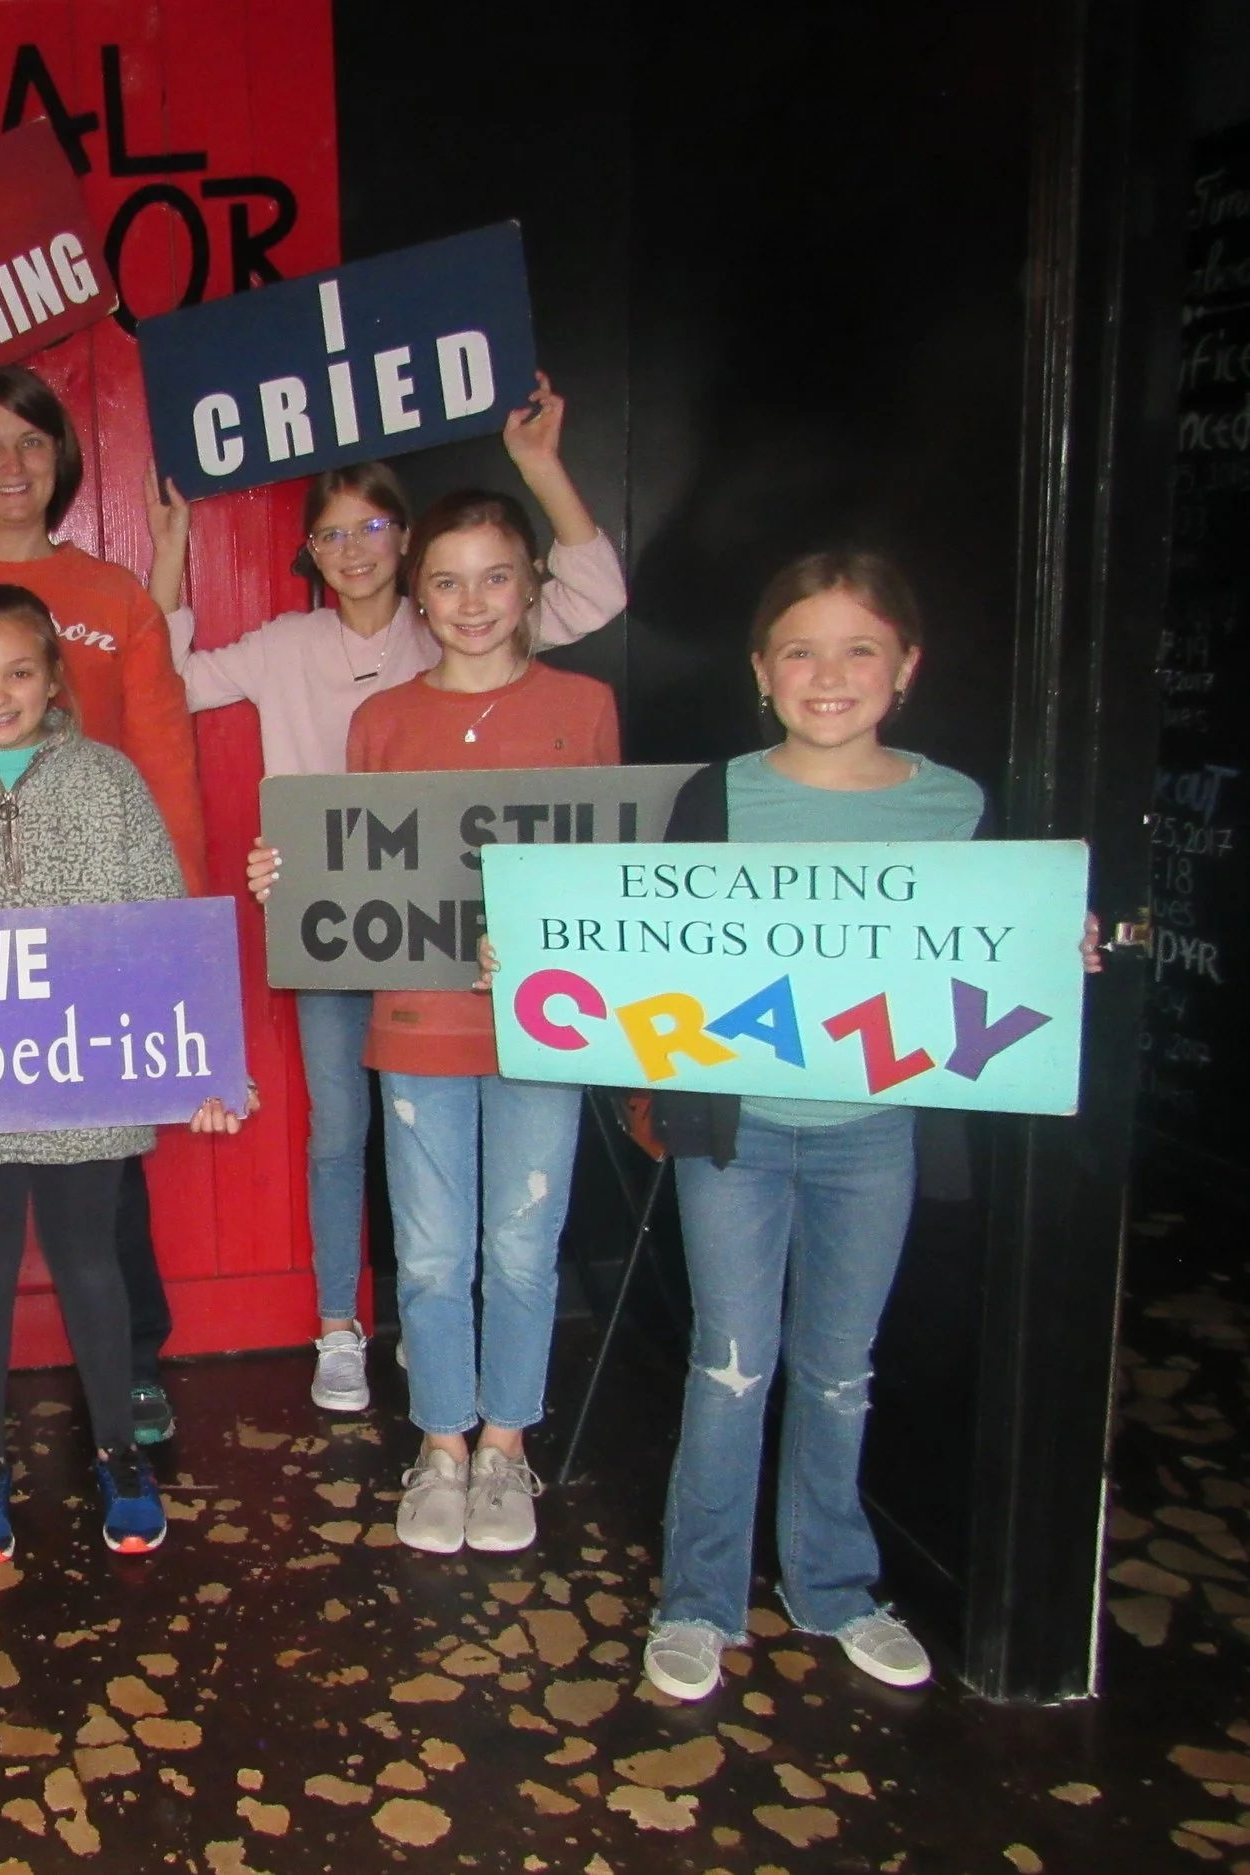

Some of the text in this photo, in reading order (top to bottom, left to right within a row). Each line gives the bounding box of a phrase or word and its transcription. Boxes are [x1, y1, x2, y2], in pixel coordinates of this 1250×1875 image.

[318, 279, 346, 355] I
[192, 330, 496, 477] CRIED
[325, 806, 419, 872] I'M
[618, 863, 918, 902] ESCAPING
[539, 917, 1016, 963] BRINGS OUT MY
[513, 967, 1054, 1096] CRAZY
